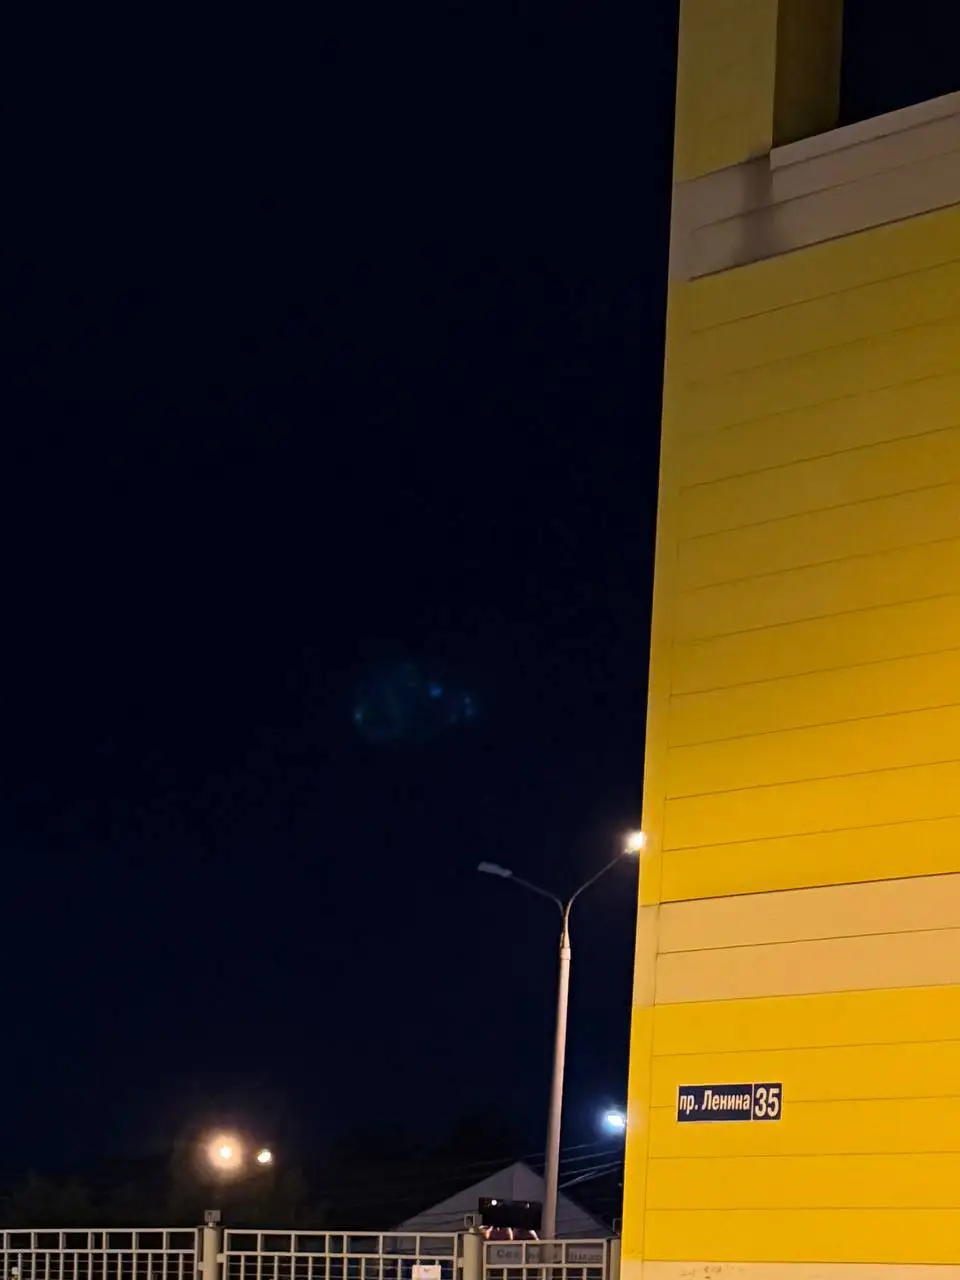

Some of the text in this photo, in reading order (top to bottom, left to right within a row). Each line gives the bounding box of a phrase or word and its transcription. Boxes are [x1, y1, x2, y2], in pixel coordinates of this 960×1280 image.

[679, 1087, 780, 1117] пр. Ленина 35
